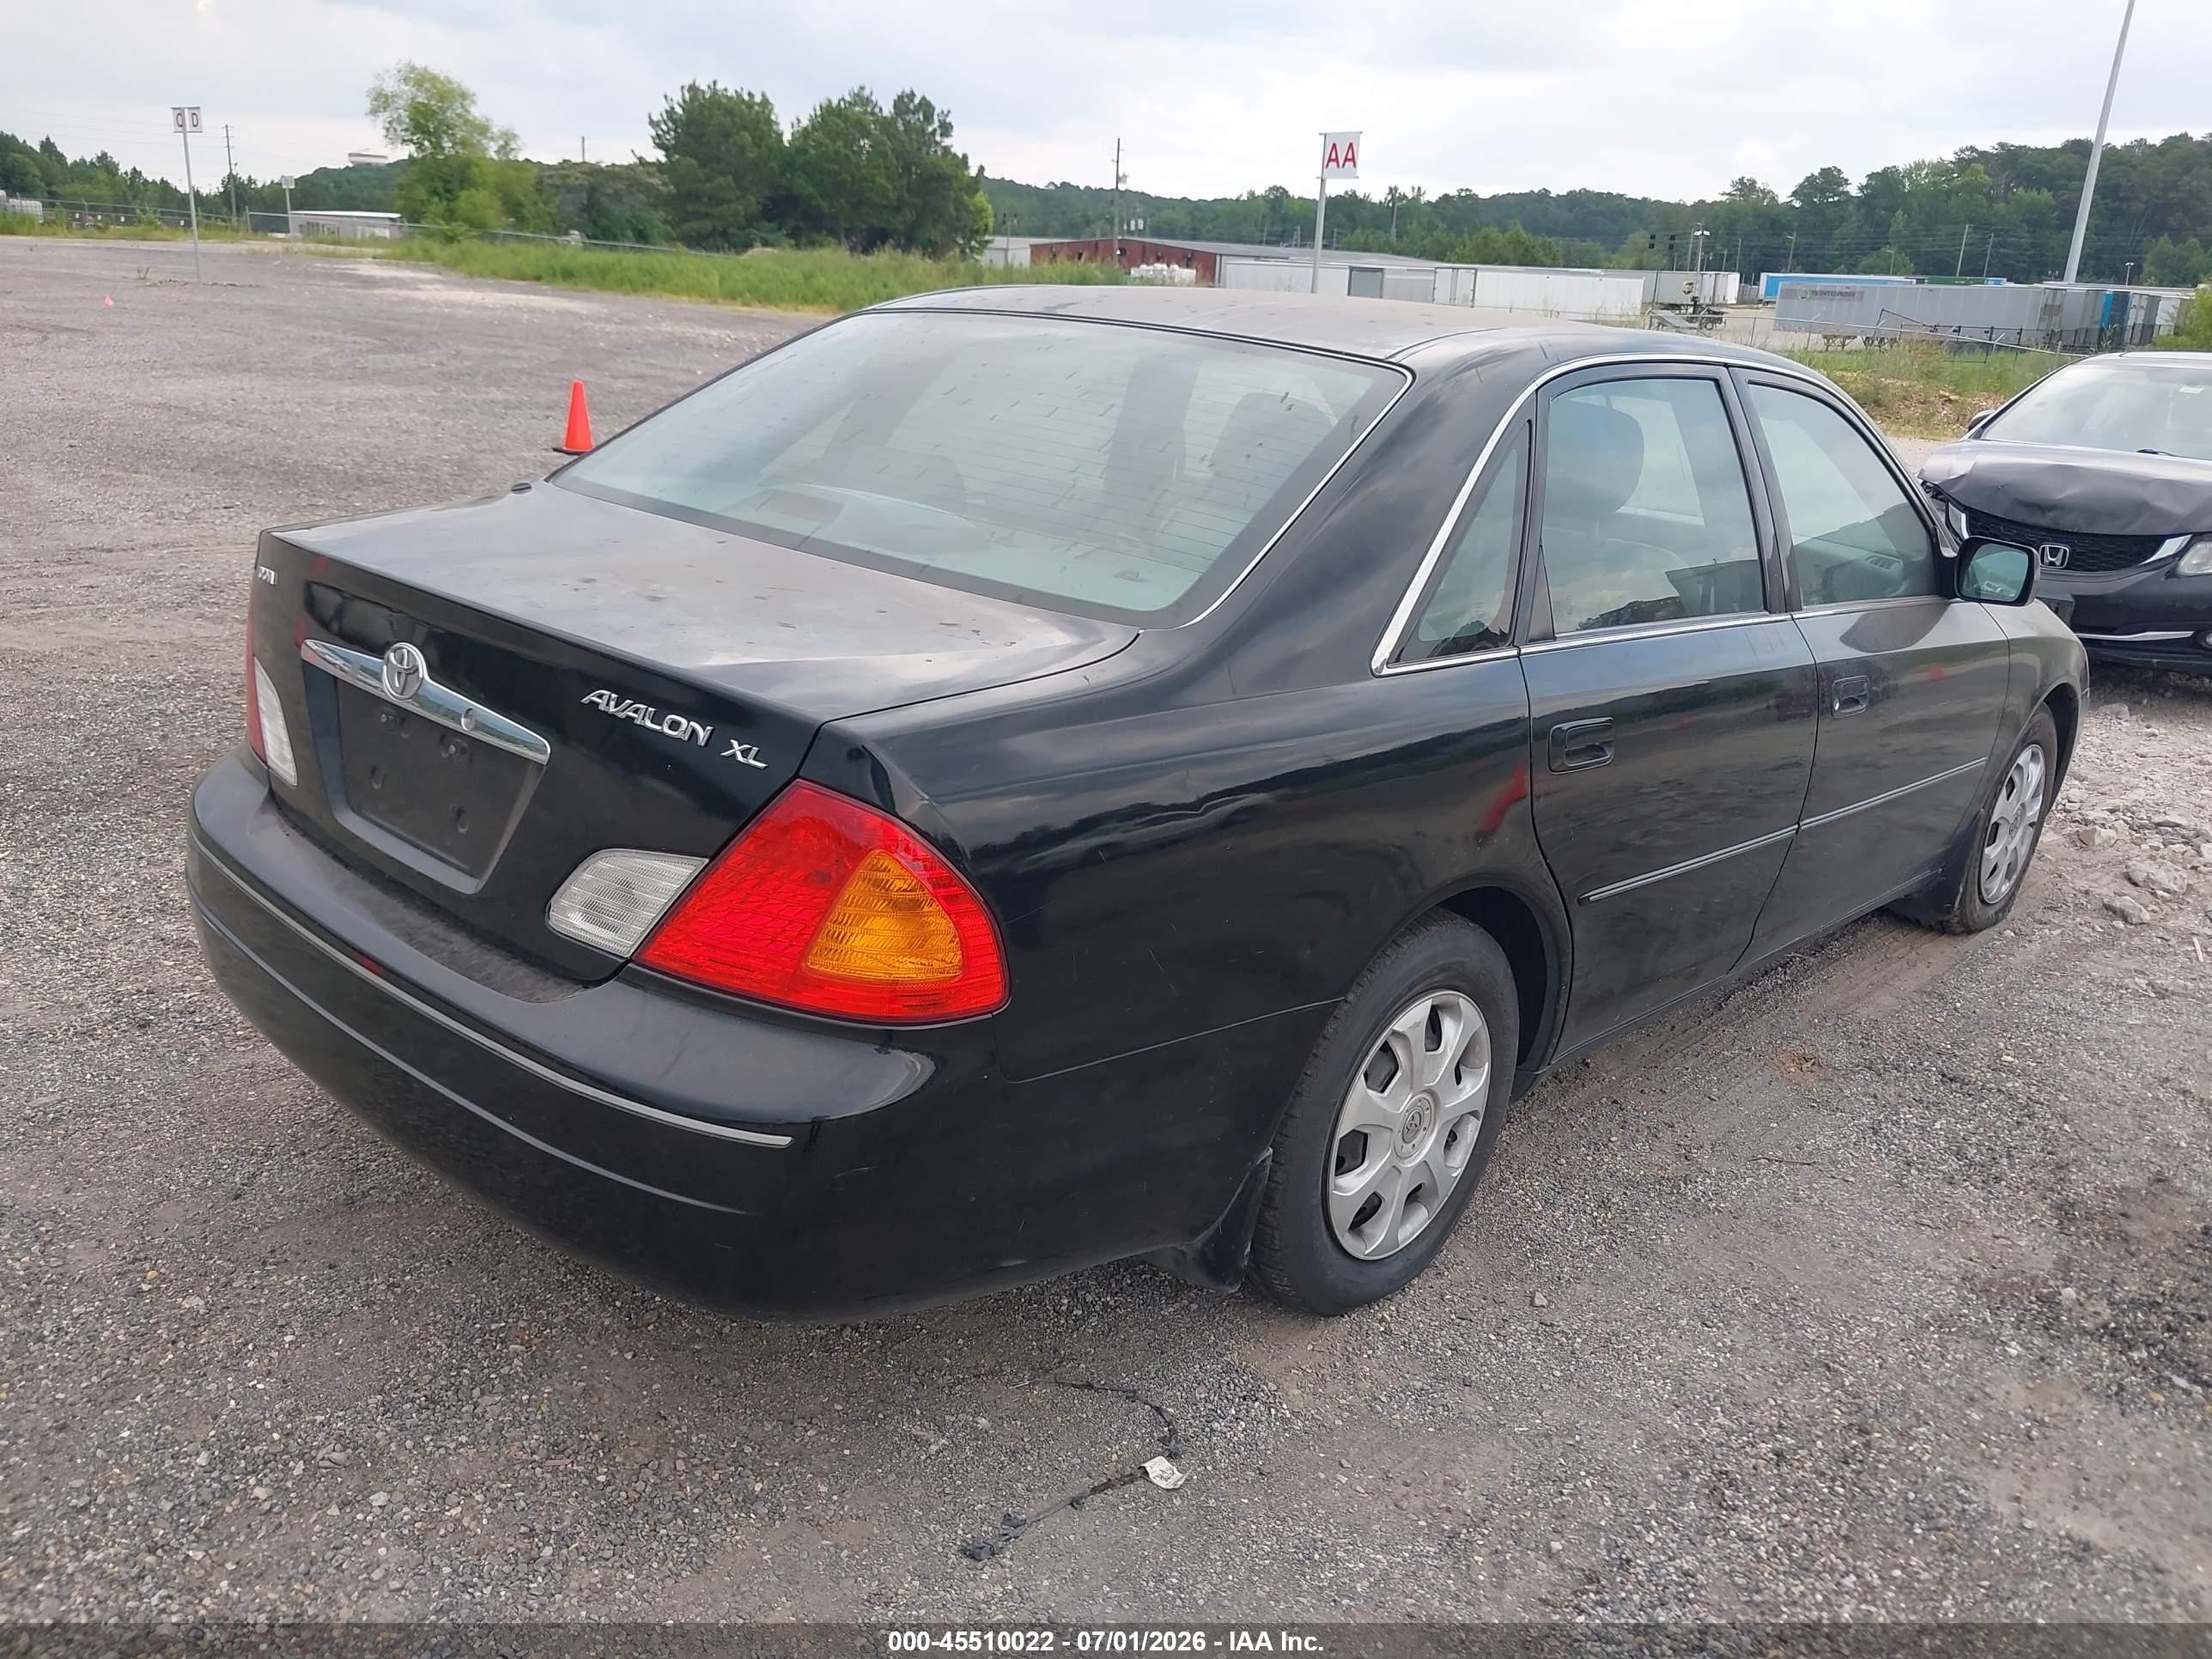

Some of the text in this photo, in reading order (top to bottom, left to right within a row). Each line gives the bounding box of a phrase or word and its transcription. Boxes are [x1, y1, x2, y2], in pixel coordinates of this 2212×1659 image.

[1325, 142, 1357, 168] AA
[580, 690, 769, 769] AVALON XL
